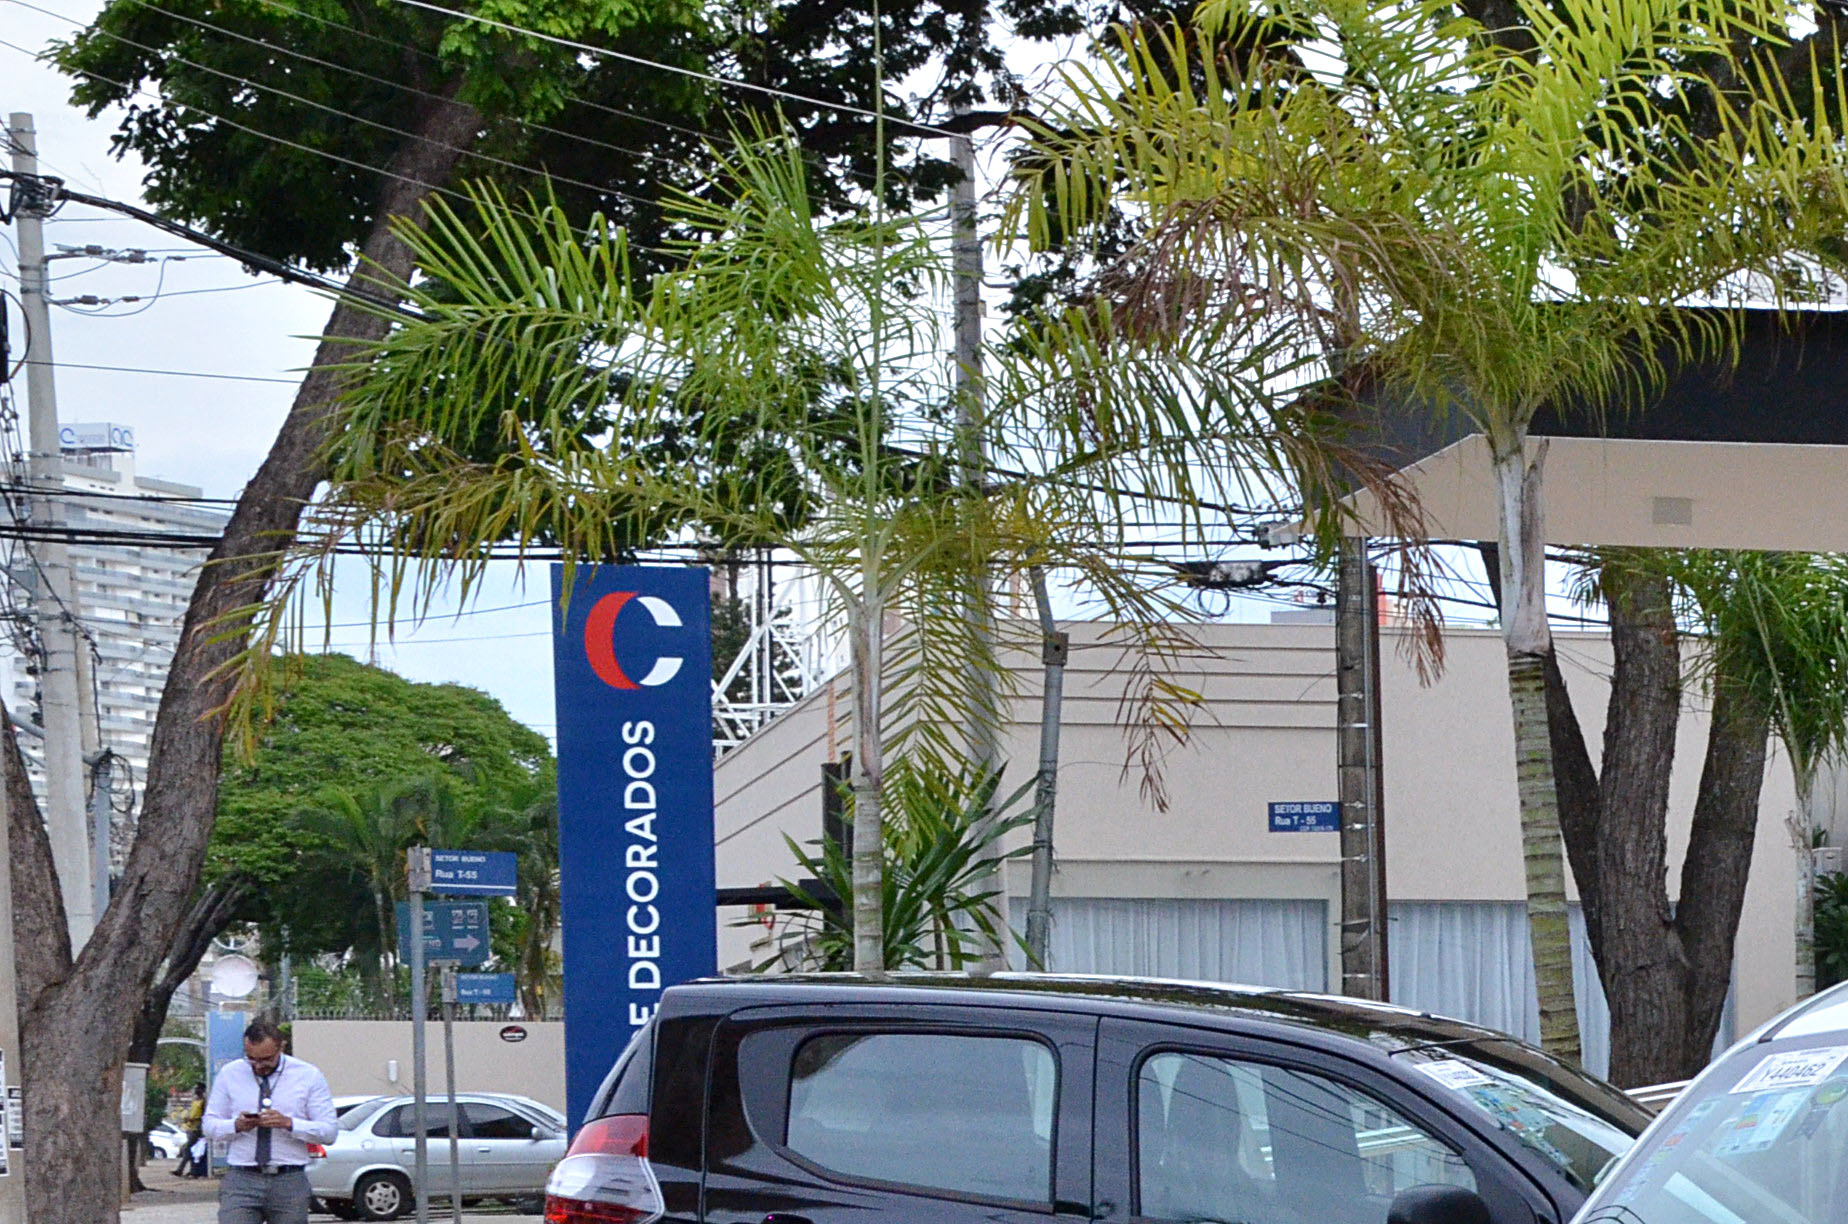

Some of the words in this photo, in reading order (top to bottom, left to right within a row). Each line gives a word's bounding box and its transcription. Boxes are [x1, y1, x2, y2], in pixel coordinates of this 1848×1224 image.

[1274, 804, 1302, 814] SETOR
[1303, 804, 1333, 813] BUENO
[1275, 816, 1291, 825] Rua
[1293, 816, 1299, 825] T
[1306, 816, 1317, 825] 55
[621, 720, 661, 989] DECORADOS
[435, 869, 454, 879] Rua
[457, 870, 478, 879] T-55
